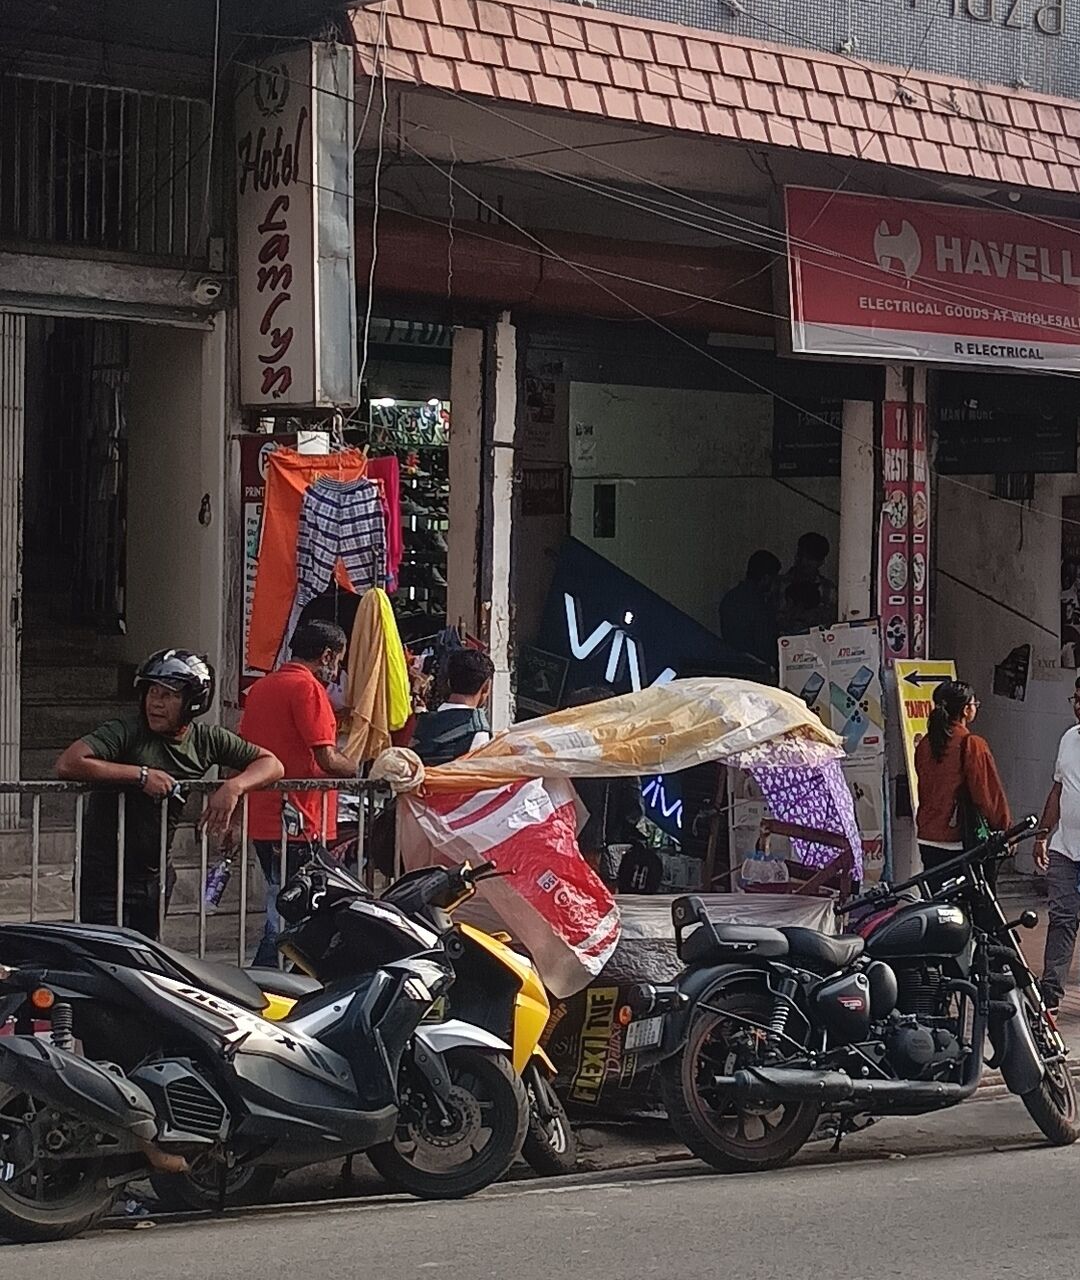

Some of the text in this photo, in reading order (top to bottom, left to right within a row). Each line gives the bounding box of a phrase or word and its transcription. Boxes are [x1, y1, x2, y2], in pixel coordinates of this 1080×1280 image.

[238, 106, 309, 195] Hotel
[858, 296, 942, 316] ELECTRICAL
[944, 303, 989, 321] GOODS
[992, 308, 1009, 321] AT
[954, 342, 1045, 361] R ELECTRICAL
